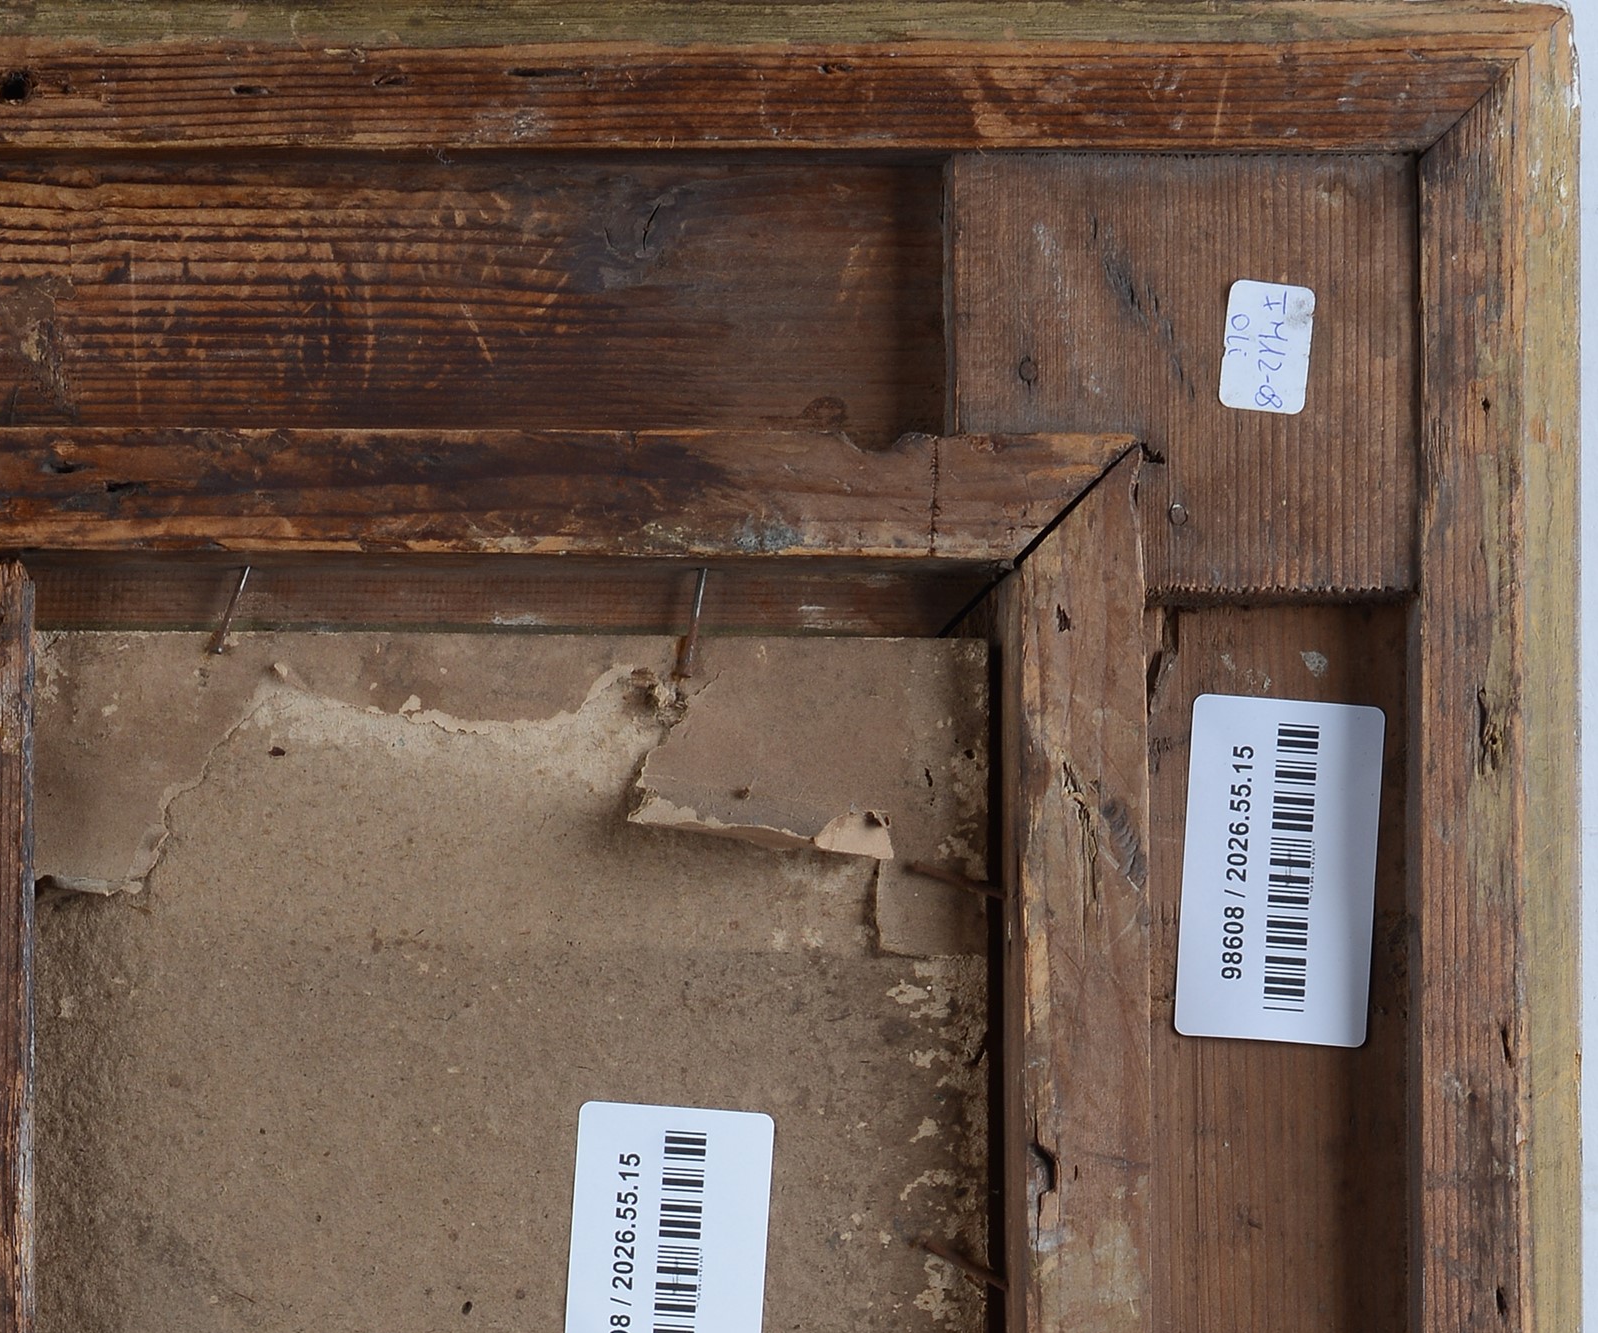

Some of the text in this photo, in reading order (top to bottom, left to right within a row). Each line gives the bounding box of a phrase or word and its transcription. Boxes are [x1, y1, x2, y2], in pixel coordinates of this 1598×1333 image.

[1221, 745, 1255, 980] 98608 / 2026.55.15
[612, 1153, 641, 1291] 2026.55.15
[610, 1297, 632, 1307] /
